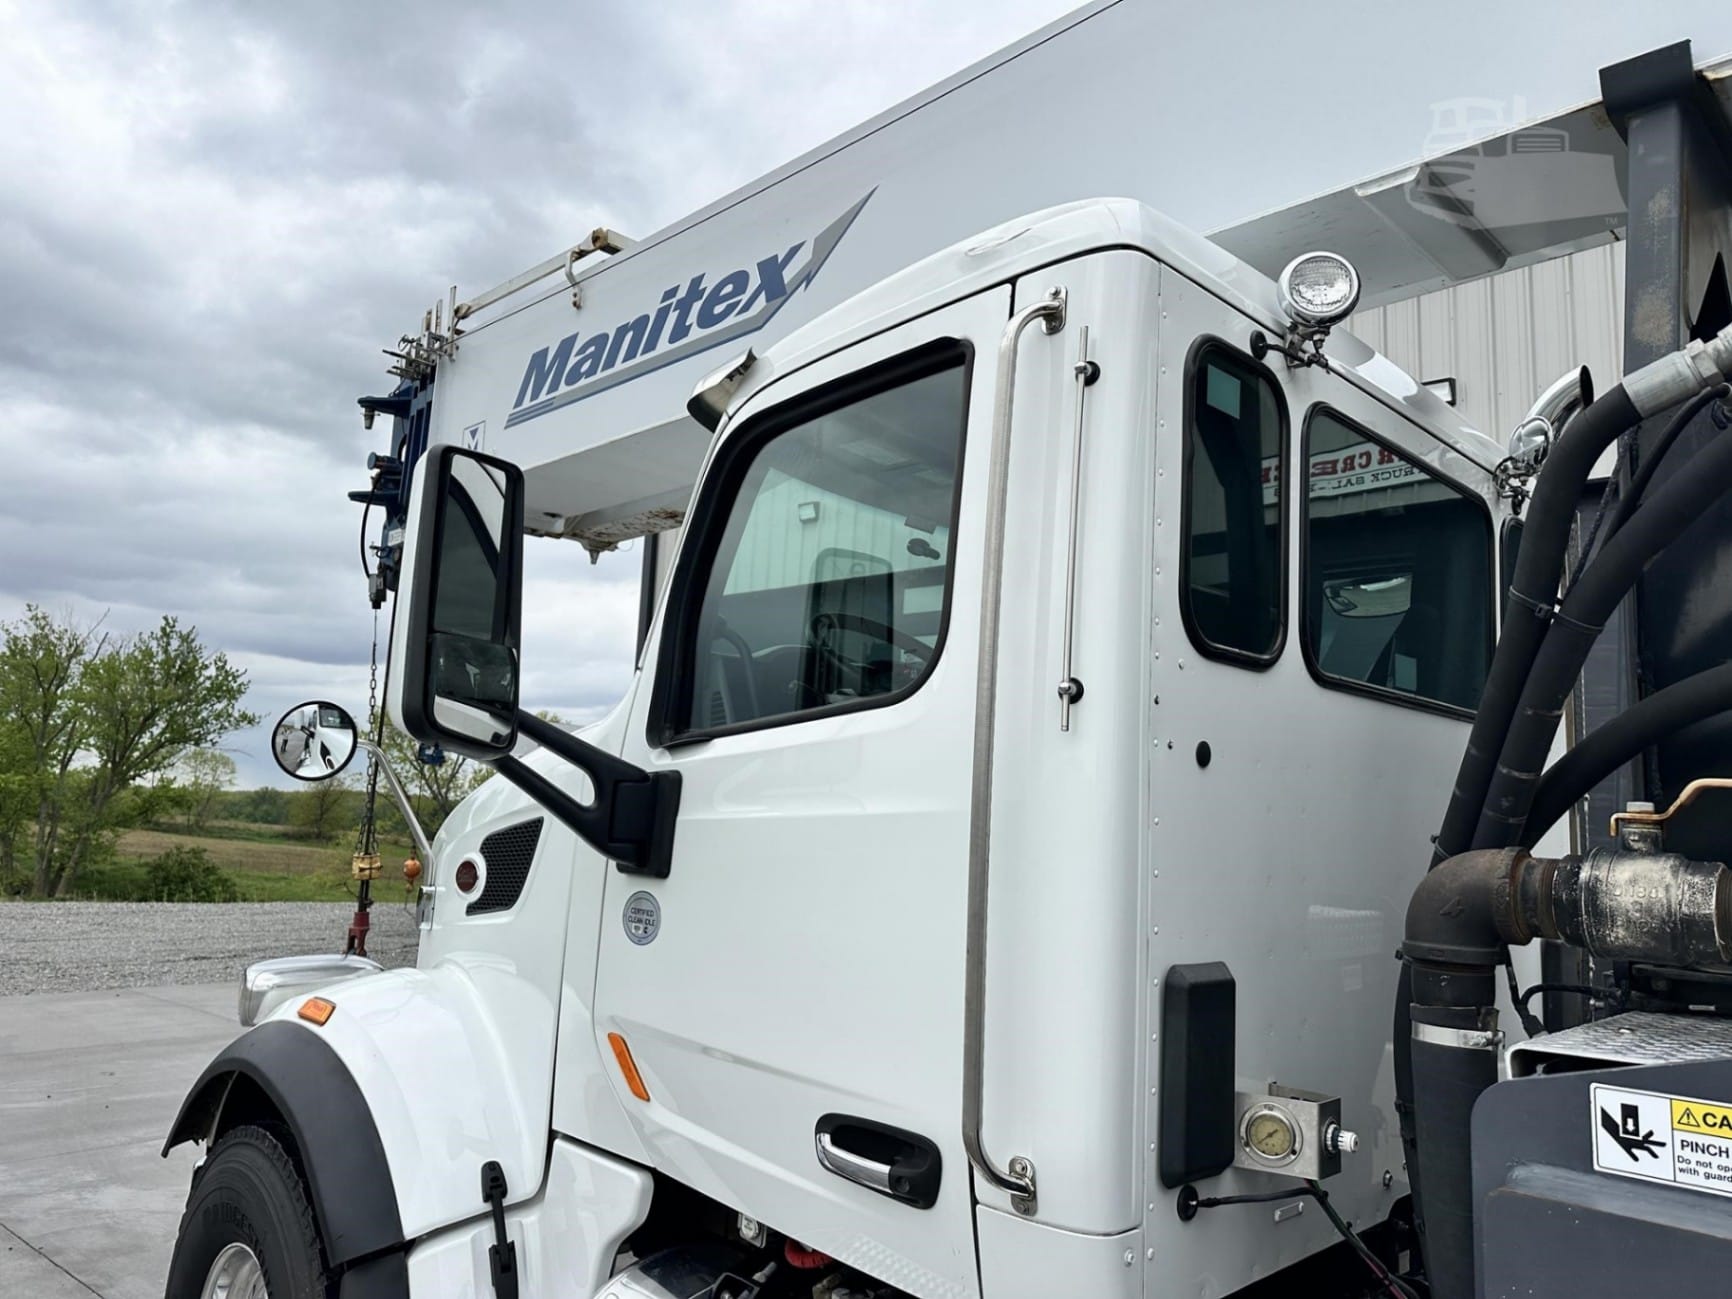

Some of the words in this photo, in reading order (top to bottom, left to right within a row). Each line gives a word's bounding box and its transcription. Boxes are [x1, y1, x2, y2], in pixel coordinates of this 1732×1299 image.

[513, 240, 807, 409] Manitex
[1680, 1139, 1730, 1159] PINCH
[1677, 1155, 1692, 1165] Do
[1695, 1160, 1712, 1169] not
[1678, 1166, 1699, 1176] with
[1703, 1171, 1732, 1183] guard
